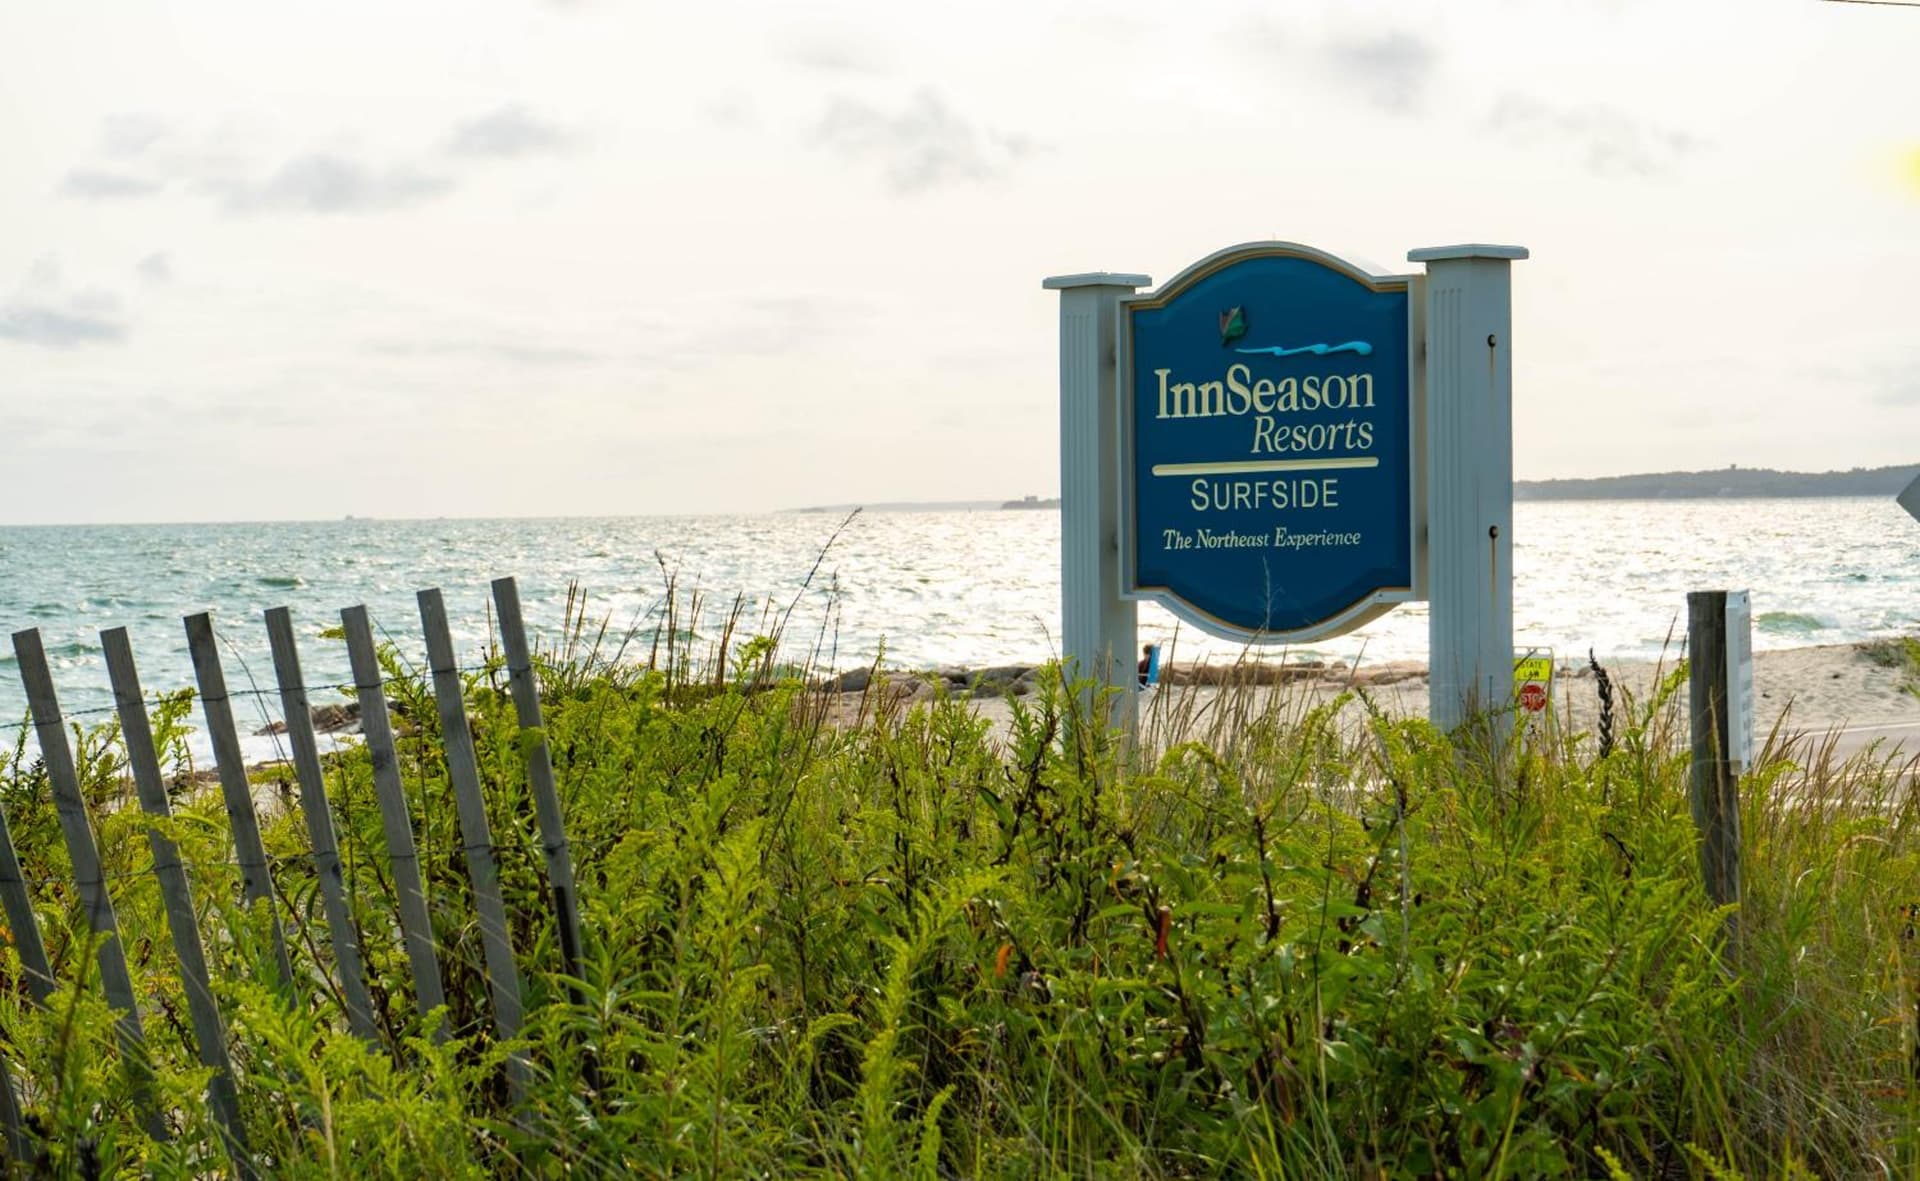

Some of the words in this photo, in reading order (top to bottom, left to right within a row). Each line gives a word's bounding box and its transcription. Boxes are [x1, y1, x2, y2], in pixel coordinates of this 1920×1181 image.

[1154, 364, 1375, 419] InnSeason
[1250, 415, 1374, 453] Resorts
[1191, 478, 1339, 511] SURFSIDE
[1163, 529, 1192, 550] The
[1195, 529, 1269, 549] Northeast
[1274, 527, 1361, 550] Experience
